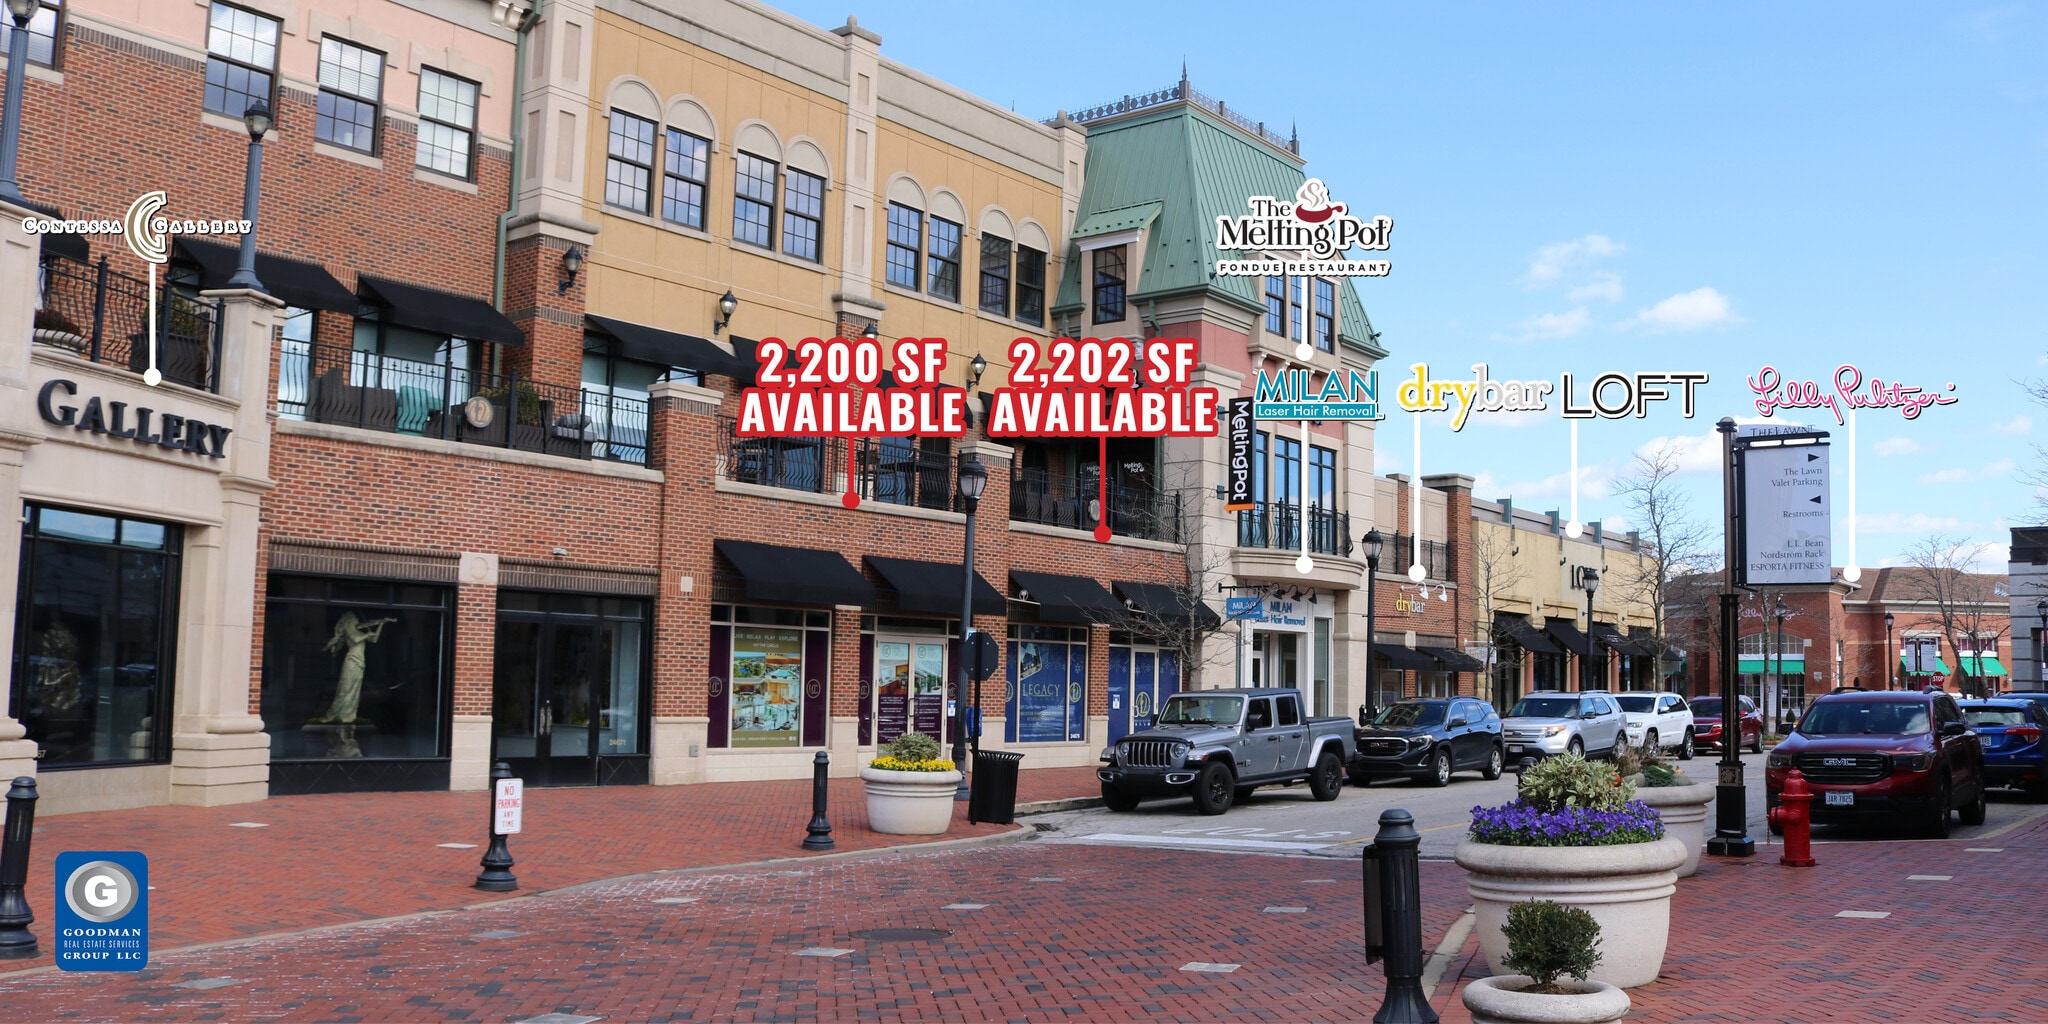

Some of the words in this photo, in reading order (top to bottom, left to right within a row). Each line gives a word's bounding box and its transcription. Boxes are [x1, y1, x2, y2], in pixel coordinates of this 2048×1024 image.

[37, 379, 233, 459] GALLERY
[1784, 468, 1799, 476] The
[1801, 467, 1823, 475] Lawn
[1771, 478, 1790, 487] Valet
[1792, 477, 1823, 487] Parking
[1783, 510, 1824, 518] Restrooms
[1805, 539, 1824, 547] Bean
[1760, 550, 1803, 559] Nordstrom
[1804, 549, 1824, 558] Rack
[1750, 563, 1787, 571] ESPORTA
[1789, 562, 1825, 570] FITNESS
[1270, 601, 1293, 613] MILAN
[1396, 592, 1426, 619] drybar
[1022, 684, 1061, 697] LEGACY
[1823, 758, 1856, 766] GMC
[504, 786, 514, 796] NO
[498, 798, 520, 808] PARKING
